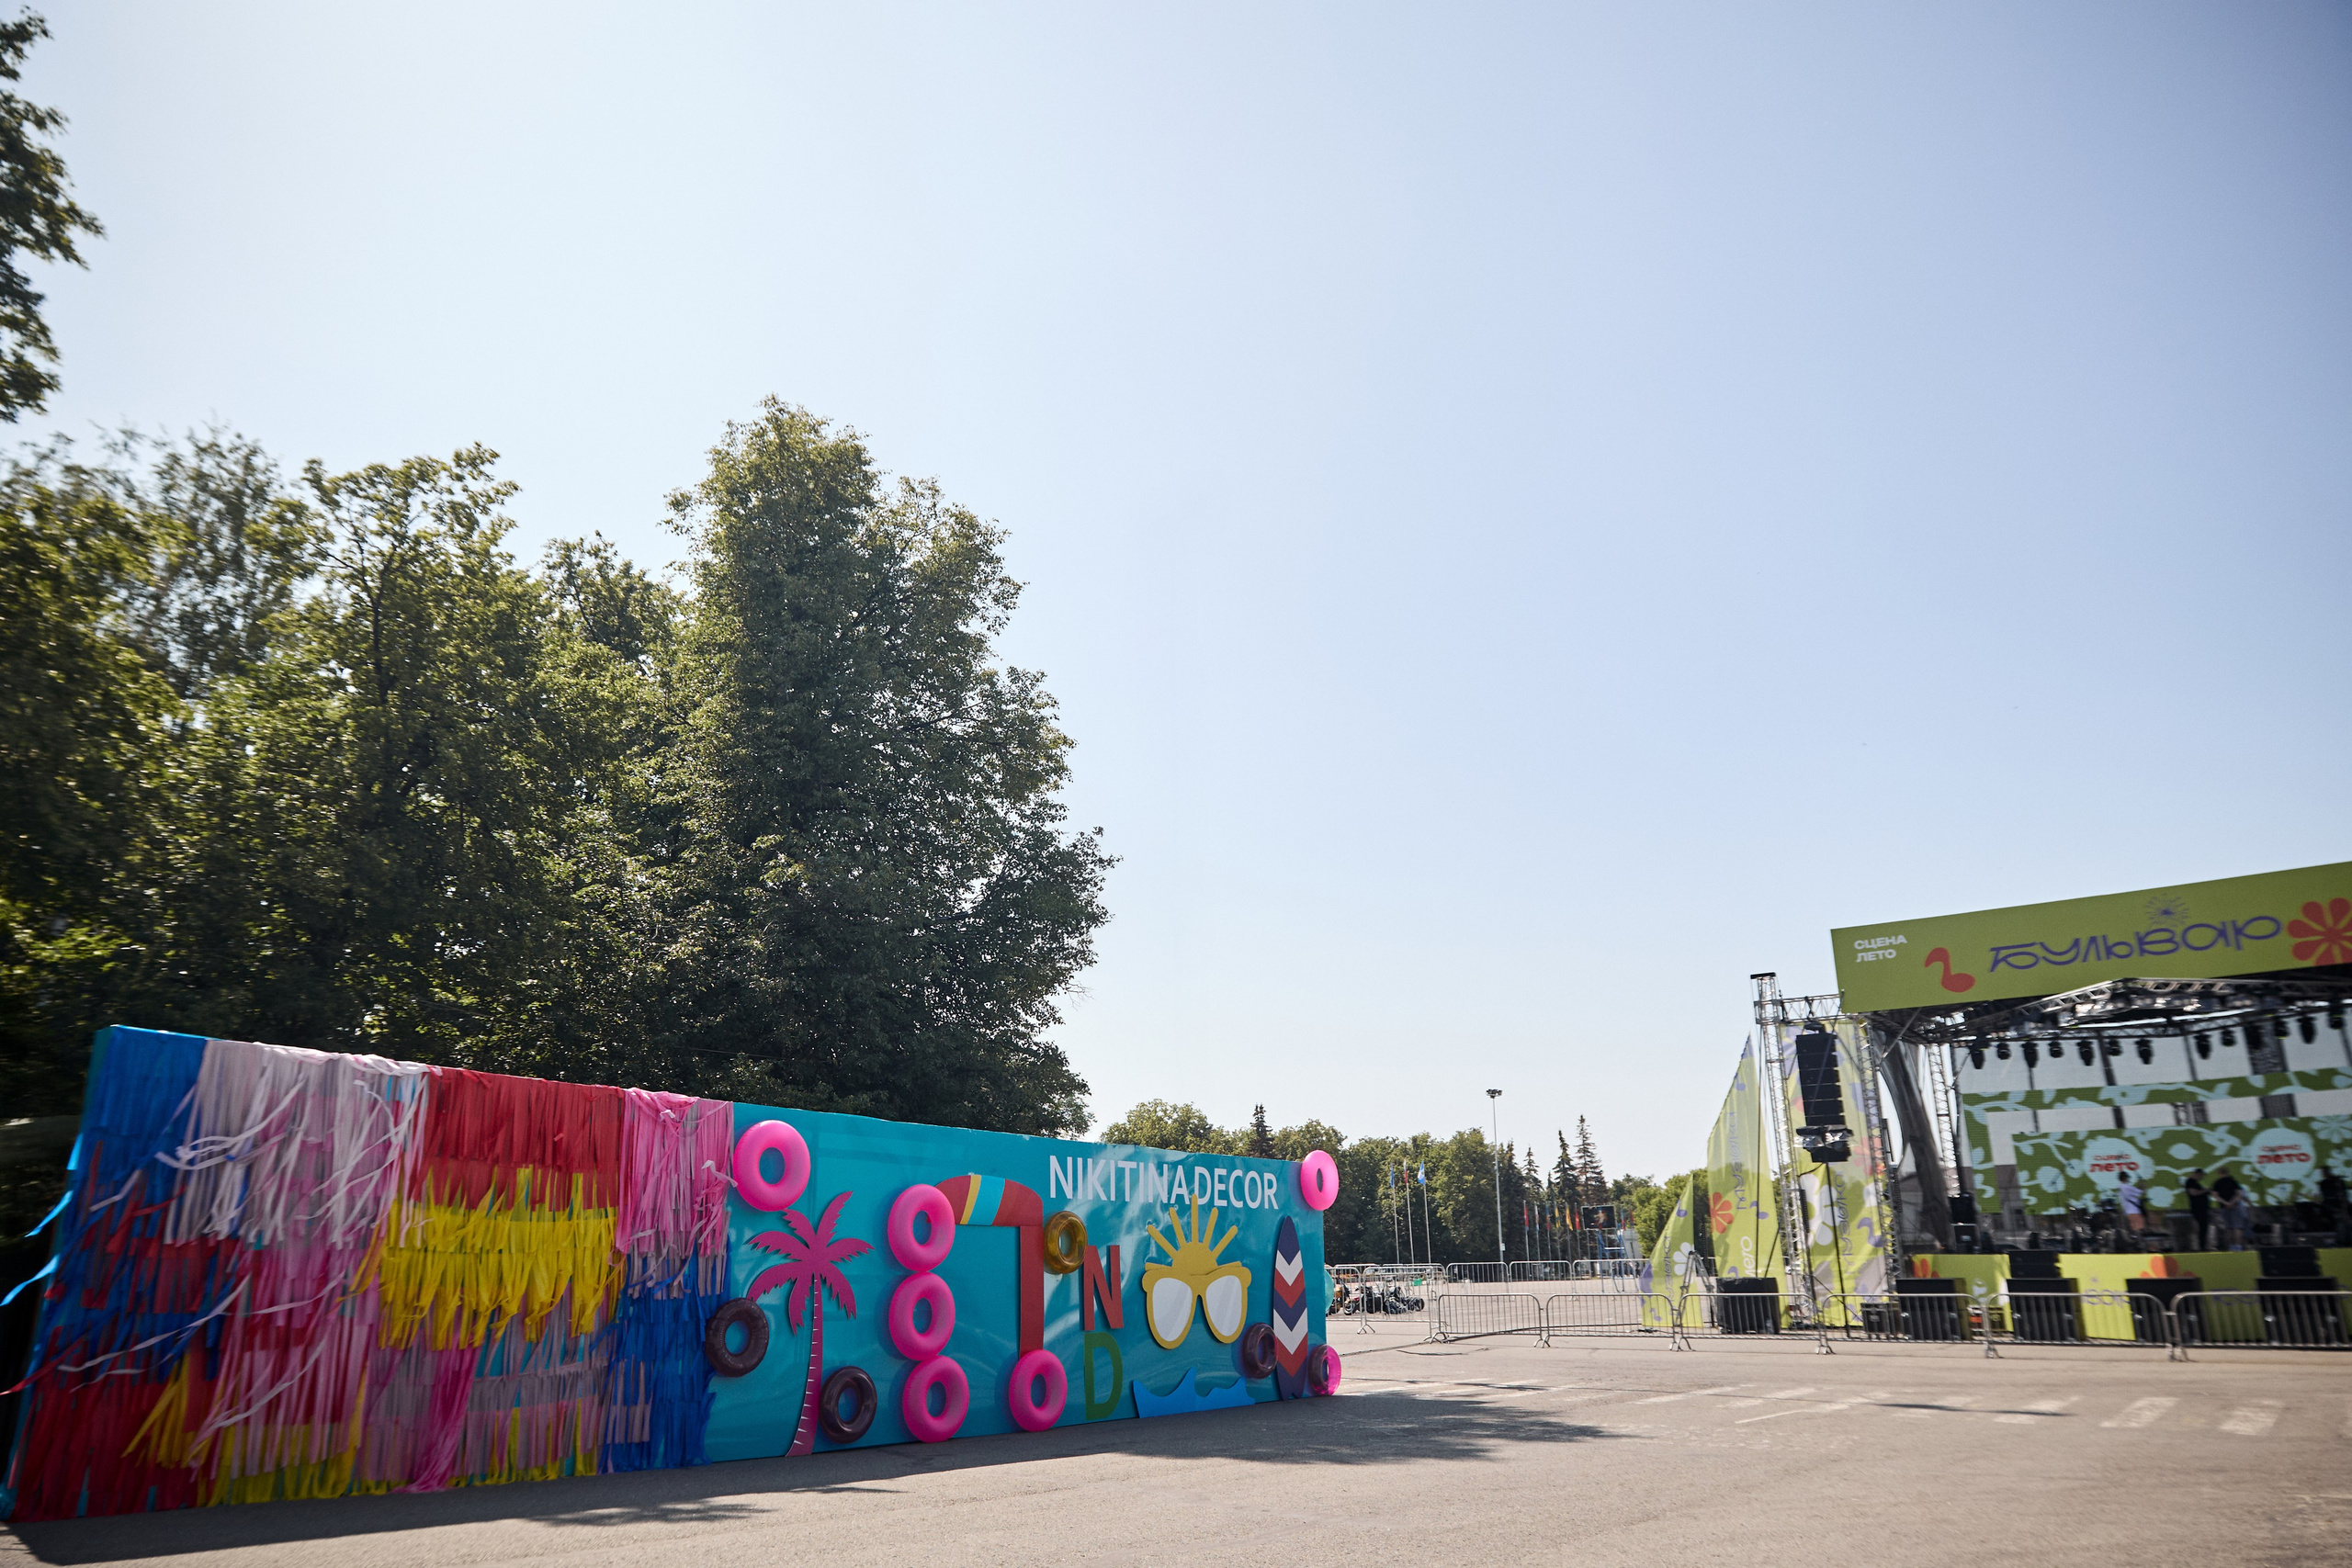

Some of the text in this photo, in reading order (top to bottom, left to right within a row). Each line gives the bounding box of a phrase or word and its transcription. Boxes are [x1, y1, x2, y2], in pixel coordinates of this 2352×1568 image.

[1854, 935, 1907, 949] СЦЕНА
[1856, 949, 1896, 963] ЛЕТО
[1049, 1155, 1279, 1210] NIKITINADECOR
